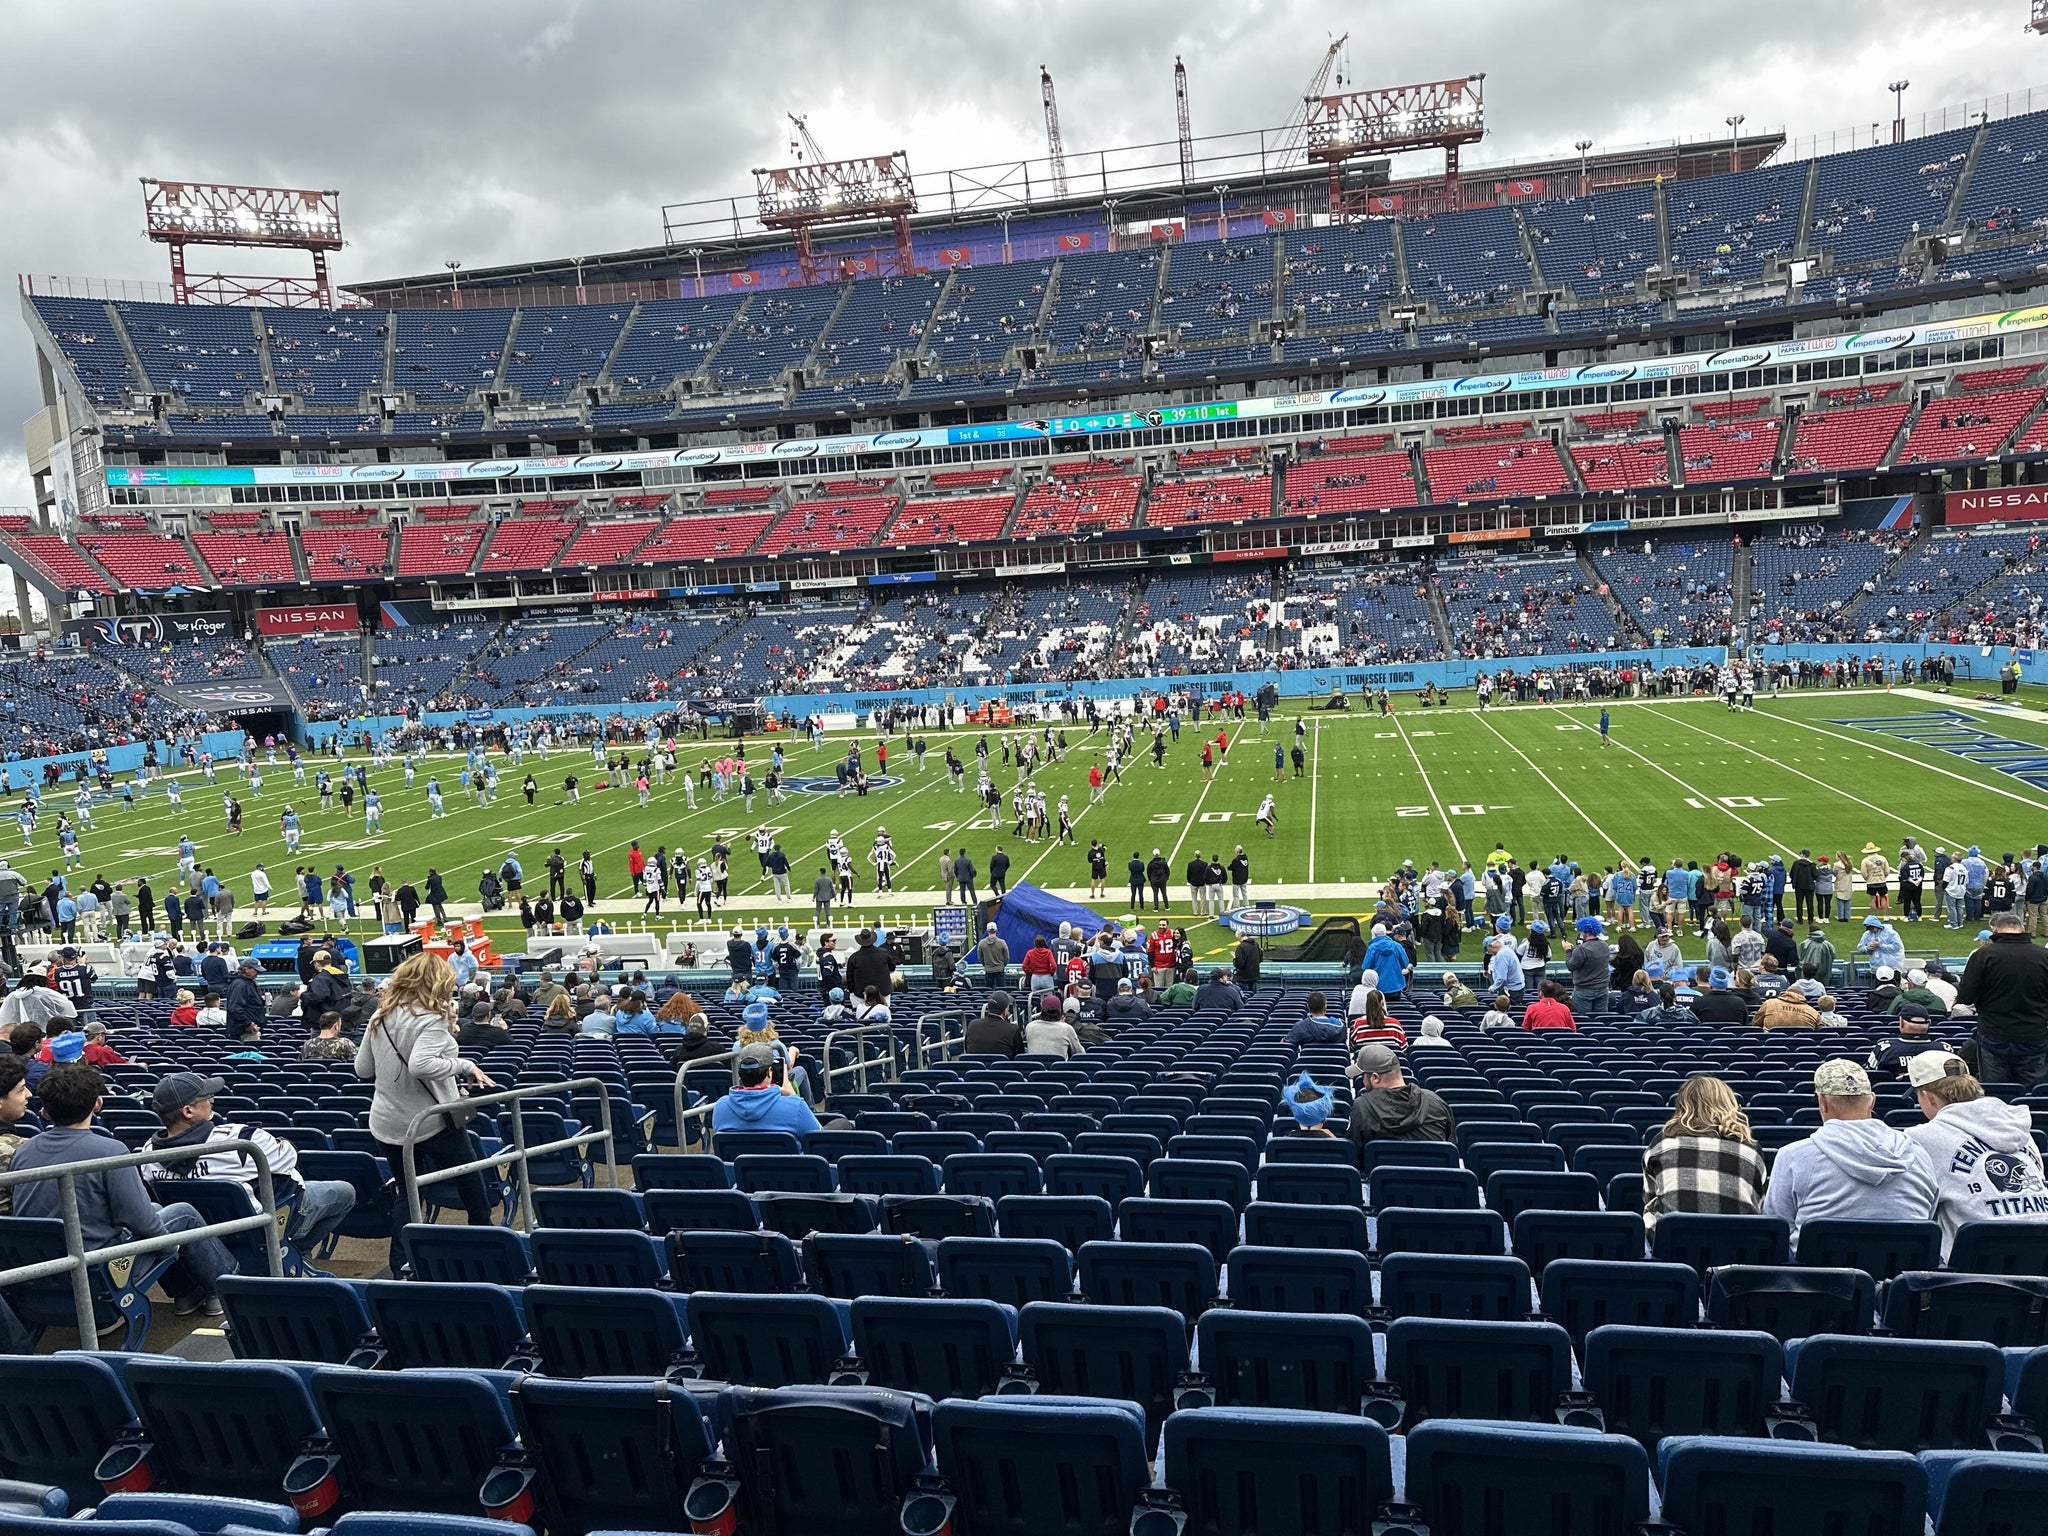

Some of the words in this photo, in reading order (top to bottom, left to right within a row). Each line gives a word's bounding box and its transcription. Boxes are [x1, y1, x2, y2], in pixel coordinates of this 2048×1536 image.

[2007, 312, 2048, 326] ImperialD
[1853, 334, 1906, 348] ImperialDade
[1713, 353, 1762, 365] ImperialDade
[1583, 368, 1629, 379] ImperialDade
[1460, 379, 1504, 390] ImperialDade
[1336, 391, 1379, 402] ImperialDade
[1172, 406, 1209, 422] 39:10
[1216, 407, 1229, 416] 1st
[1070, 421, 1080, 431] 0
[1107, 417, 1116, 427] 0
[960, 431, 973, 439] 1st
[879, 436, 916, 446] ImperialDade
[777, 445, 813, 455] ImperialDade
[579, 458, 617, 468] ImperialDade
[679, 453, 715, 462] ImperialDade
[356, 469, 399, 478] ImperialDade
[473, 463, 512, 473] ImperialDade
[1961, 492, 2048, 509] NISSA
[1461, 531, 1485, 540] Tito's
[1546, 525, 1579, 535] Pinnacle
[1458, 549, 1498, 558] CAMPBELL
[1315, 560, 1342, 568] BETHEA
[790, 596, 821, 604] HOUSTON
[530, 607, 547, 615] RING
[553, 606, 579, 614] HONOR
[270, 609, 345, 624] NISSAN
[190, 616, 226, 639] Kroger
[1346, 672, 1386, 685] TENNESSEE
[1389, 671, 1414, 684] TOUGH
[1209, 680, 1233, 692] TOUGH
[228, 706, 272, 717] NISSAN
[760, 839, 768, 848] 31
[877, 851, 888, 860] 41
[1617, 882, 1632, 893] 24
[1751, 882, 1762, 894] 75
[1993, 886, 2006, 898] 10
[446, 927, 452, 937] G
[466, 923, 472, 932] G
[1274, 921, 1299, 933] TITANS
[1158, 939, 1173, 954] 12
[478, 949, 486, 962] G
[755, 951, 766, 962] 31
[780, 953, 787, 964] 2
[1056, 951, 1069, 965] 10
[1069, 970, 1082, 982] 85
[59, 979, 85, 998] 91
[1782, 1005, 1805, 1015] TITANS
[1967, 1182, 1982, 1195] 19
